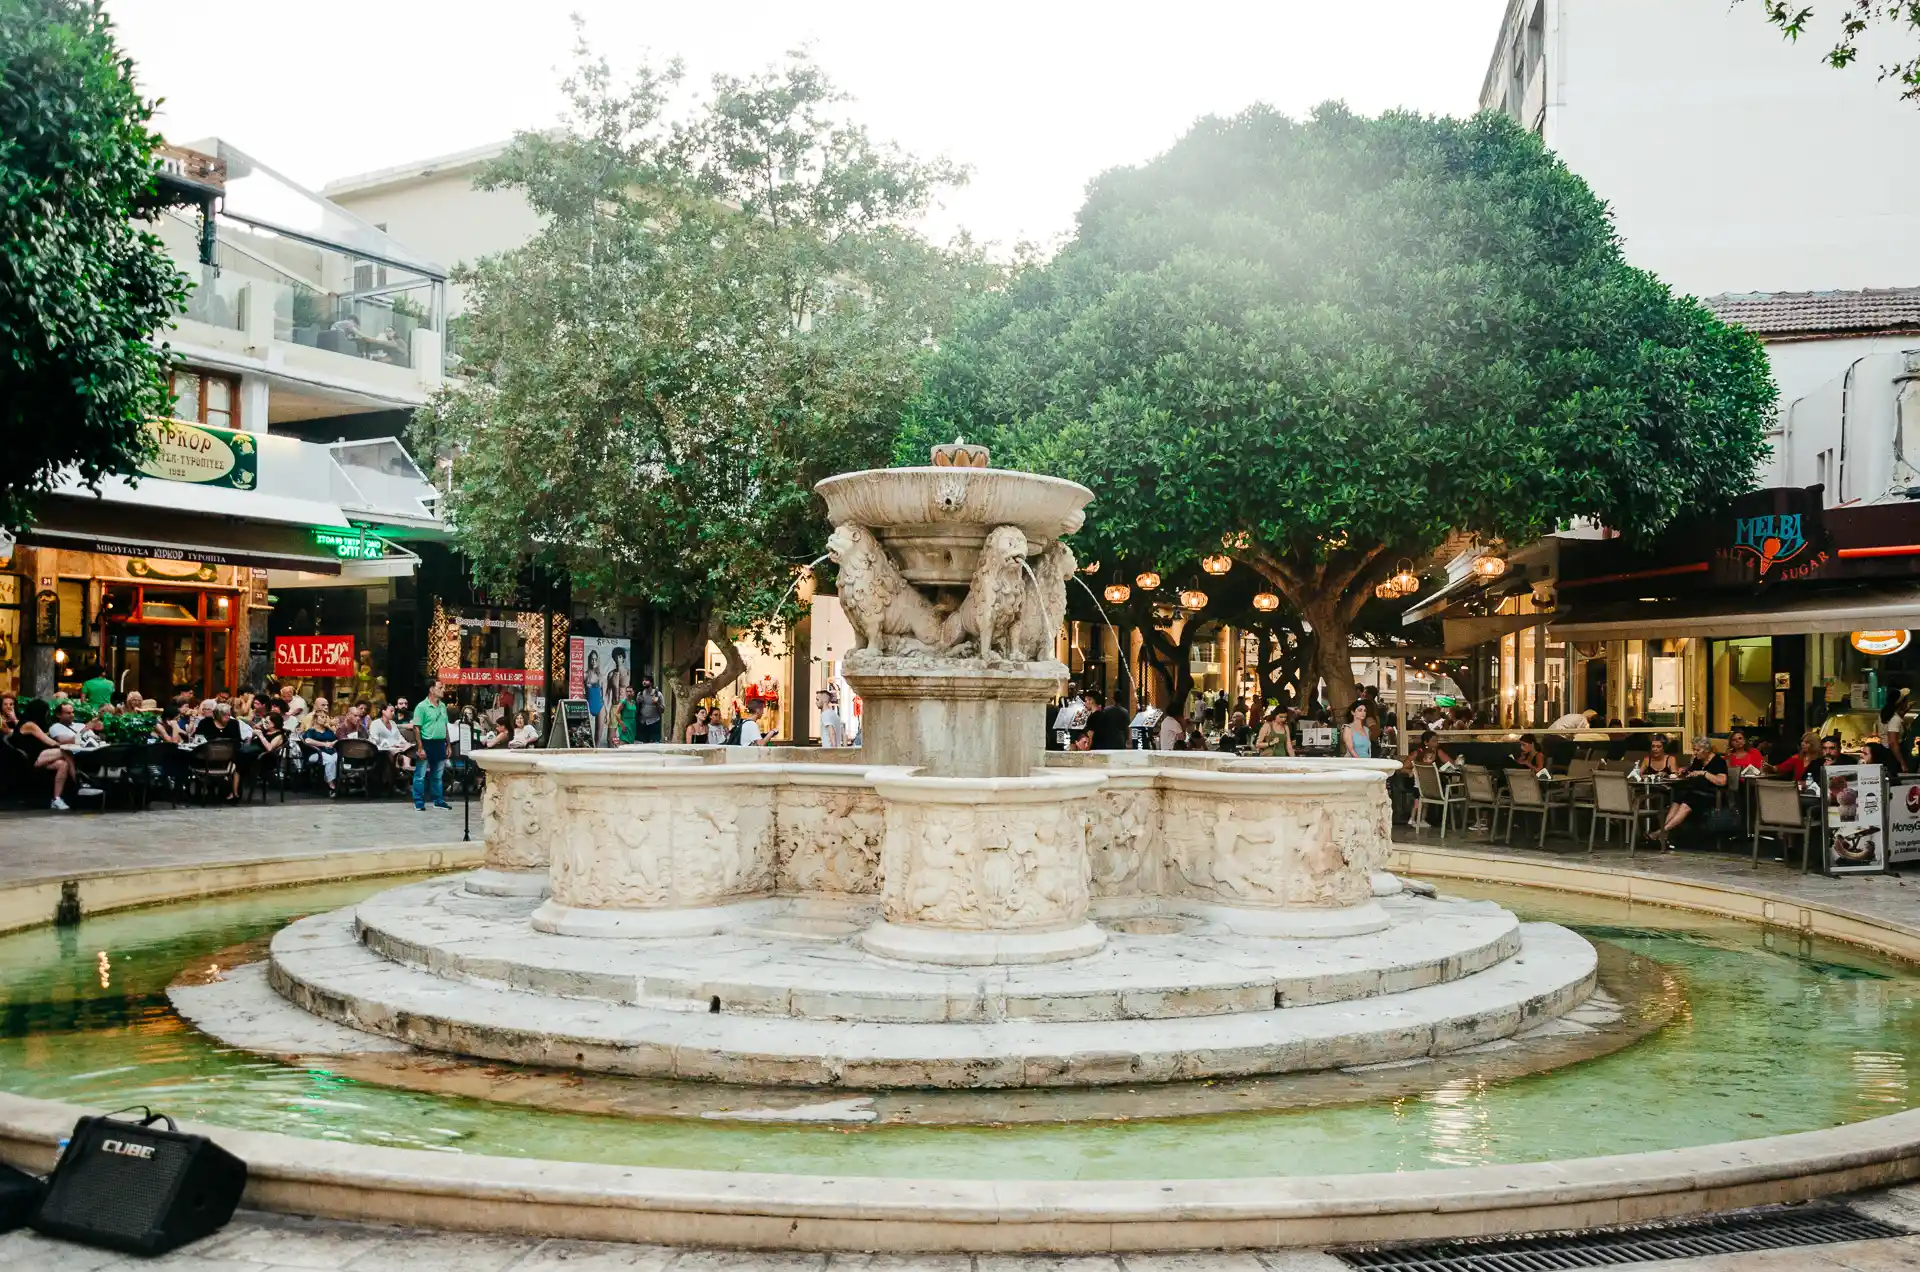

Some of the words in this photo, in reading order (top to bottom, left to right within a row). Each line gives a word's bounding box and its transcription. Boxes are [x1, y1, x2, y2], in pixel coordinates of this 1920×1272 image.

[157, 426, 212, 454] ΙΡΚΟΡ
[169, 468, 186, 477] 1922
[1734, 513, 1806, 553] MELBA
[153, 548, 184, 560] ΚΙΡΚΟΡ
[338, 544, 378, 558] ΟΠΤΚΑ
[1715, 548, 1745, 563] SALT
[1780, 551, 1829, 580] SUGAR
[456, 616, 485, 628] Shopping
[485, 619, 505, 627] Center
[277, 643, 323, 665] SALE
[461, 672, 481, 681] SALE
[494, 673, 514, 681] SALE
[102, 1139, 156, 1159] CUBE
